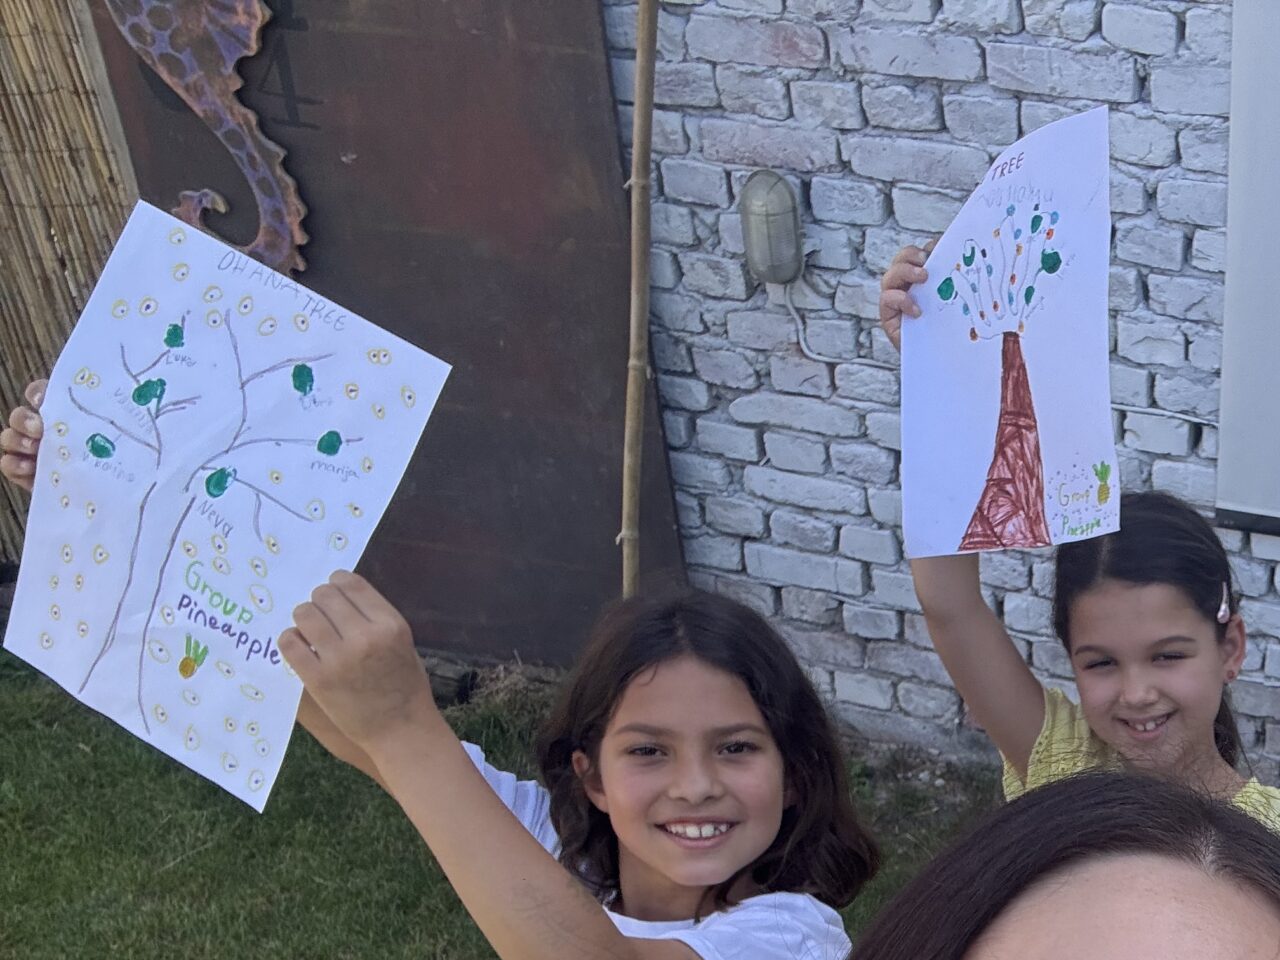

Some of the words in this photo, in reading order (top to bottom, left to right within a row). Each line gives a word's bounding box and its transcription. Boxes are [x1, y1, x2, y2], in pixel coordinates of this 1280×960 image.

[992, 151, 1025, 181] TREE
[300, 297, 347, 332] TREE
[198, 500, 236, 539] Neva
[184, 560, 255, 625] Group
